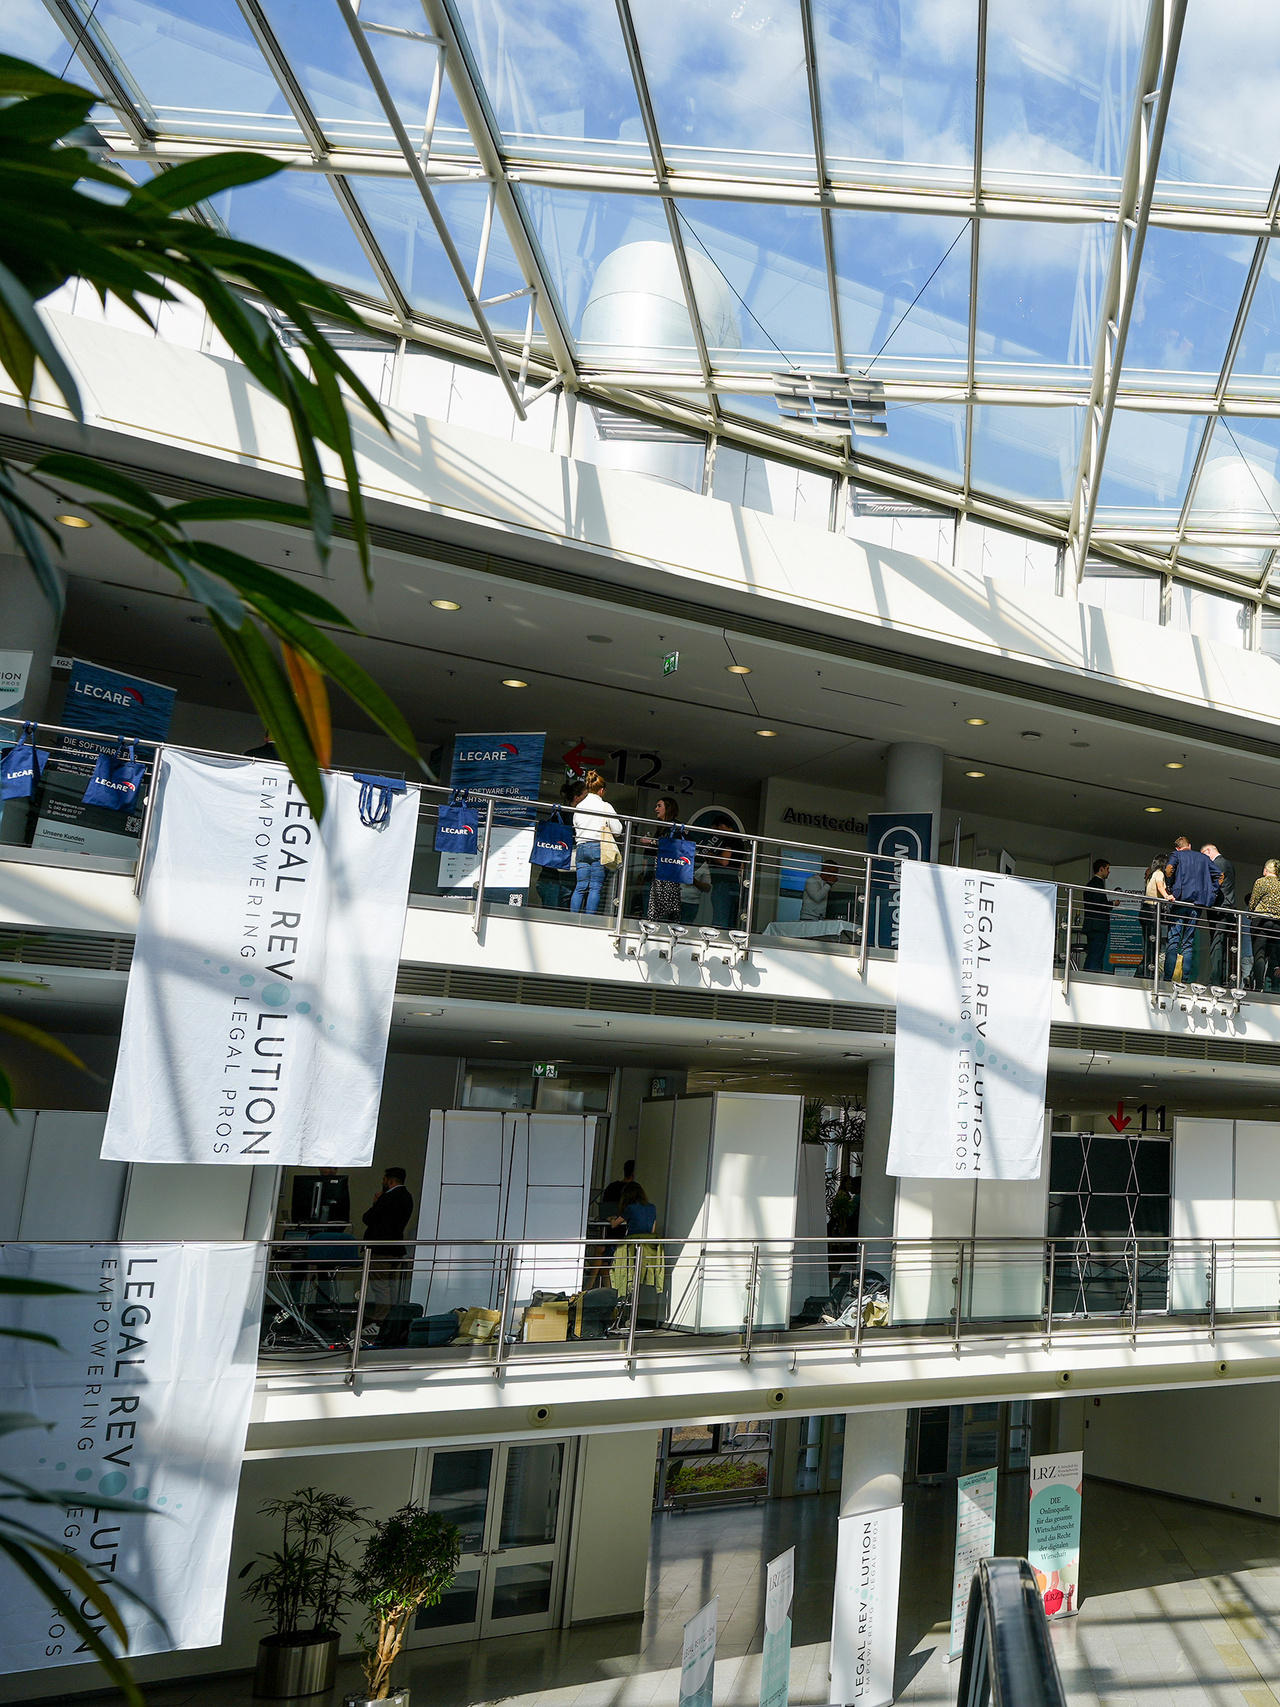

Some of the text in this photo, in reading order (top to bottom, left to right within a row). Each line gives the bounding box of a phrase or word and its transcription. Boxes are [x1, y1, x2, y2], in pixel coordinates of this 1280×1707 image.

[0, 672, 22, 680] ION
[74, 681, 132, 707] LECARE
[63, 736, 76, 747] DIE
[459, 751, 508, 761] LECARE
[95, 777, 128, 793] LECARE
[505, 786, 520, 795] FÜR
[42, 829, 85, 843] Unsere Kunden
[441, 826, 469, 836] LECARE
[536, 841, 563, 851] LECARE
[660, 856, 685, 866] LECARE
[977, 880, 995, 969] LEGAL
[213, 776, 278, 1154] EMPOWERING LEGAL PROS
[955, 879, 976, 1171] EMPOWERING LEGAL PROS
[1136, 1103, 1166, 1132] 11
[114, 1258, 158, 1377] LEGAL
[77, 1258, 118, 1452] EMPOWERING
[1033, 1465, 1057, 1481] LRZ
[1050, 1496, 1062, 1505] DIE
[1039, 1504, 1071, 1515] Onlinequelle
[1053, 1514, 1073, 1524] gesamte
[1037, 1532, 1071, 1543] und das Recht
[1039, 1541, 1069, 1552] der digitalen
[865, 1606, 874, 1694] EMPOWERING
[855, 1640, 867, 1698] LEGAL
